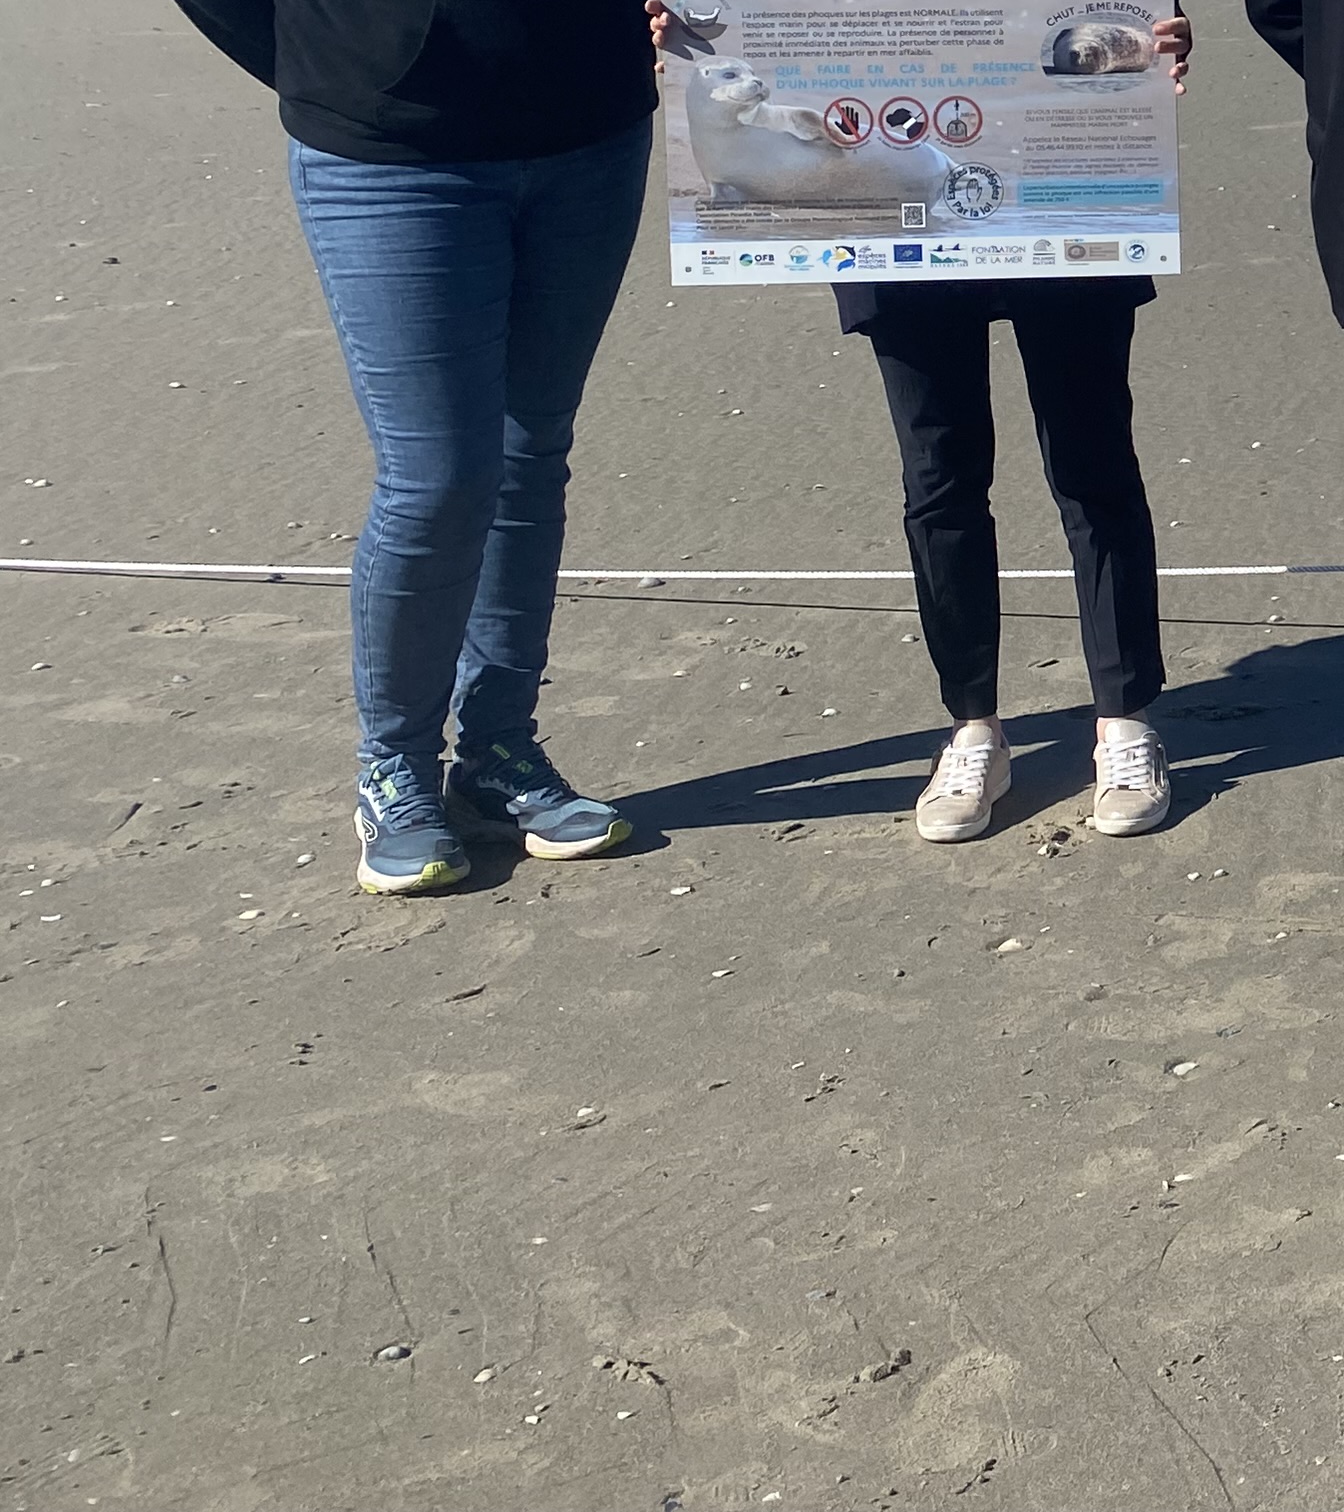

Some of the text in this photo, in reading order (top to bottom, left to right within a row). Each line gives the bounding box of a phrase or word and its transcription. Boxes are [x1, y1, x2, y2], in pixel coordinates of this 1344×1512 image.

[742, 11, 751, 19] La
[753, 11, 790, 20] présence
[808, 11, 844, 20] phoques
[872, 10, 898, 19] plages
[913, 9, 958, 17] NORMALE.
[1046, 6, 1075, 27] CHUT
[1096, 2, 1111, 12] ME
[1113, 2, 1153, 23] REPOSE
[842, 20, 878, 28] déplacer
[778, 31, 809, 39] reposer
[900, 29, 937, 37] présence
[953, 29, 996, 37] personnes
[743, 40, 783, 49] proximité
[785, 40, 830, 48] immédiate
[899, 39, 940, 47] perturber
[967, 39, 991, 47] phase
[743, 51, 766, 59] repos
[834, 49, 865, 57] repartir
[775, 61, 1036, 76] QUE FAIRE EN CAS DE PRÉSENCE
[776, 79, 808, 89] D'UN
[811, 78, 865, 89] PHOQUE
[868, 78, 916, 88] VIVANT
[922, 78, 945, 88] SUR
[949, 77, 963, 87] LA
[967, 77, 1007, 86] PLAGE
[947, 166, 1002, 201] Espèces protégées
[952, 201, 994, 217] Par la loi
[754, 254, 775, 262] OFB
[976, 255, 1023, 264] DE LA MER
